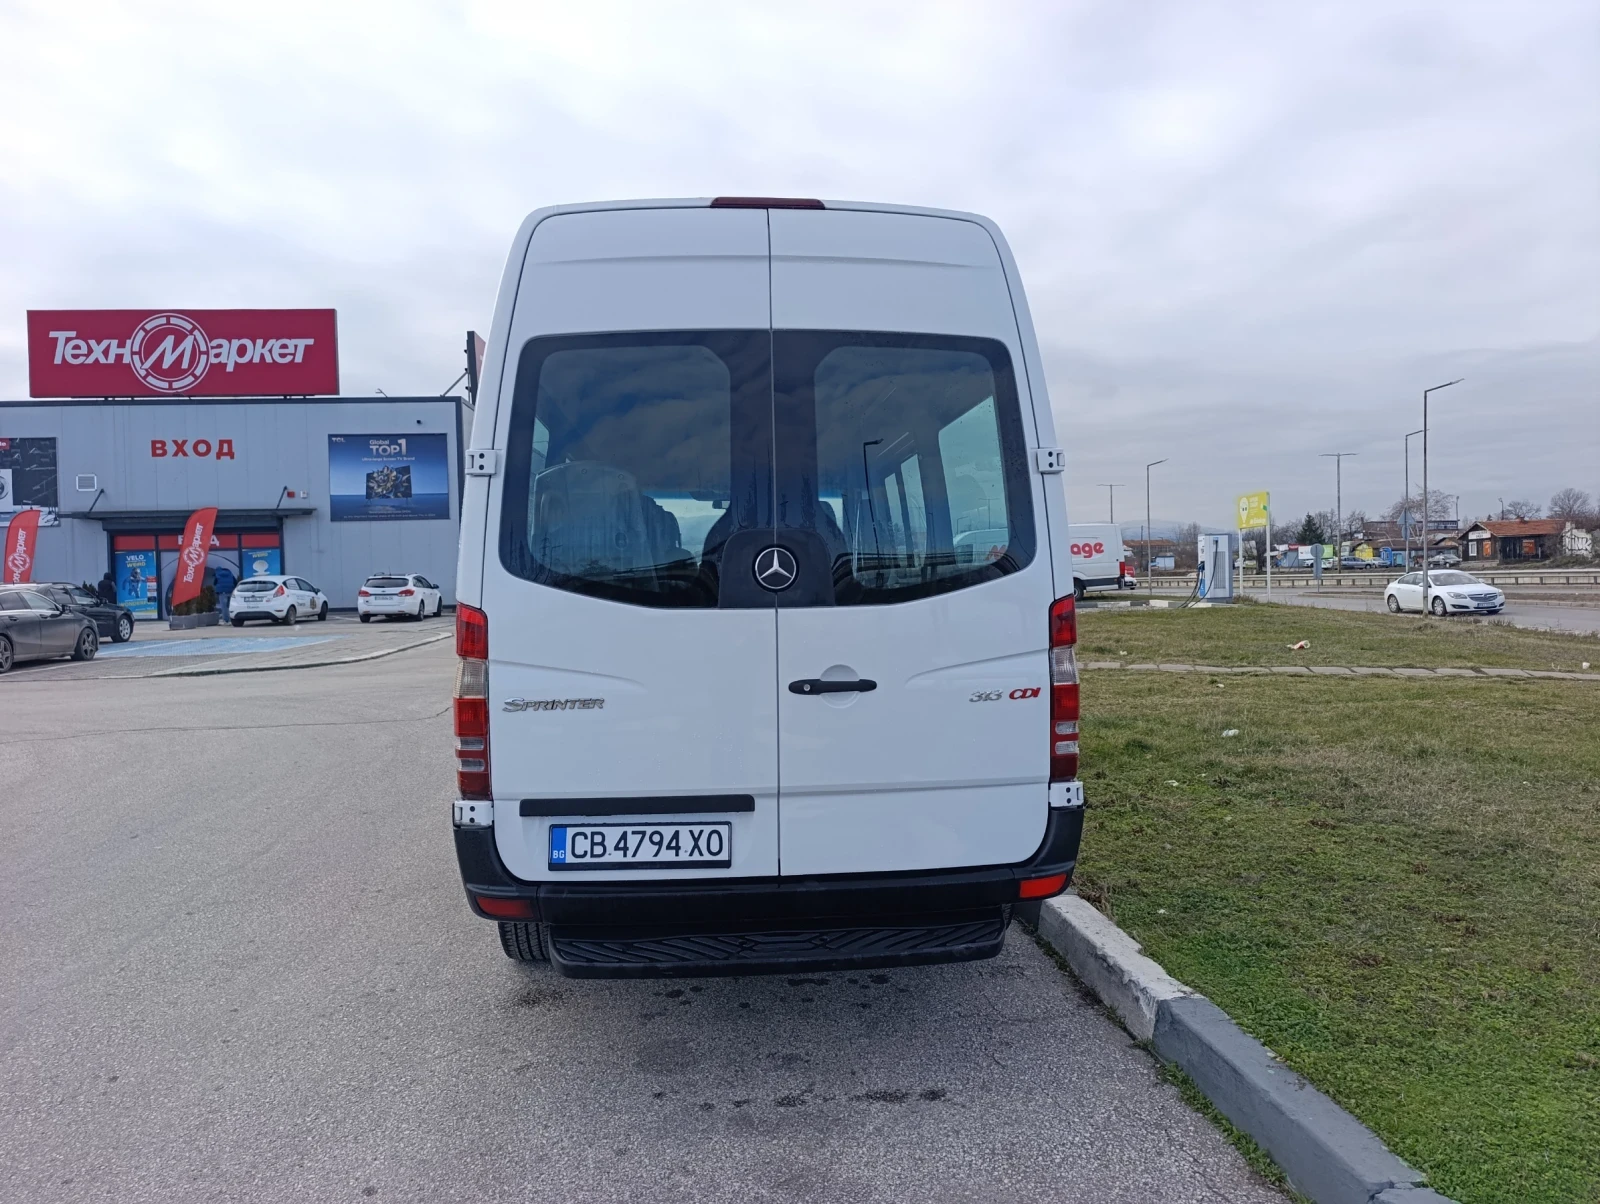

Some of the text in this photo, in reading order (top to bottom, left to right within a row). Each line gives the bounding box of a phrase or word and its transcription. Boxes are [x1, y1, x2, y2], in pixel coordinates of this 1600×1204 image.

[151, 439, 235, 460] ВХОД
[969, 687, 1042, 703] 313 CDI
[552, 850, 565, 859] BG
